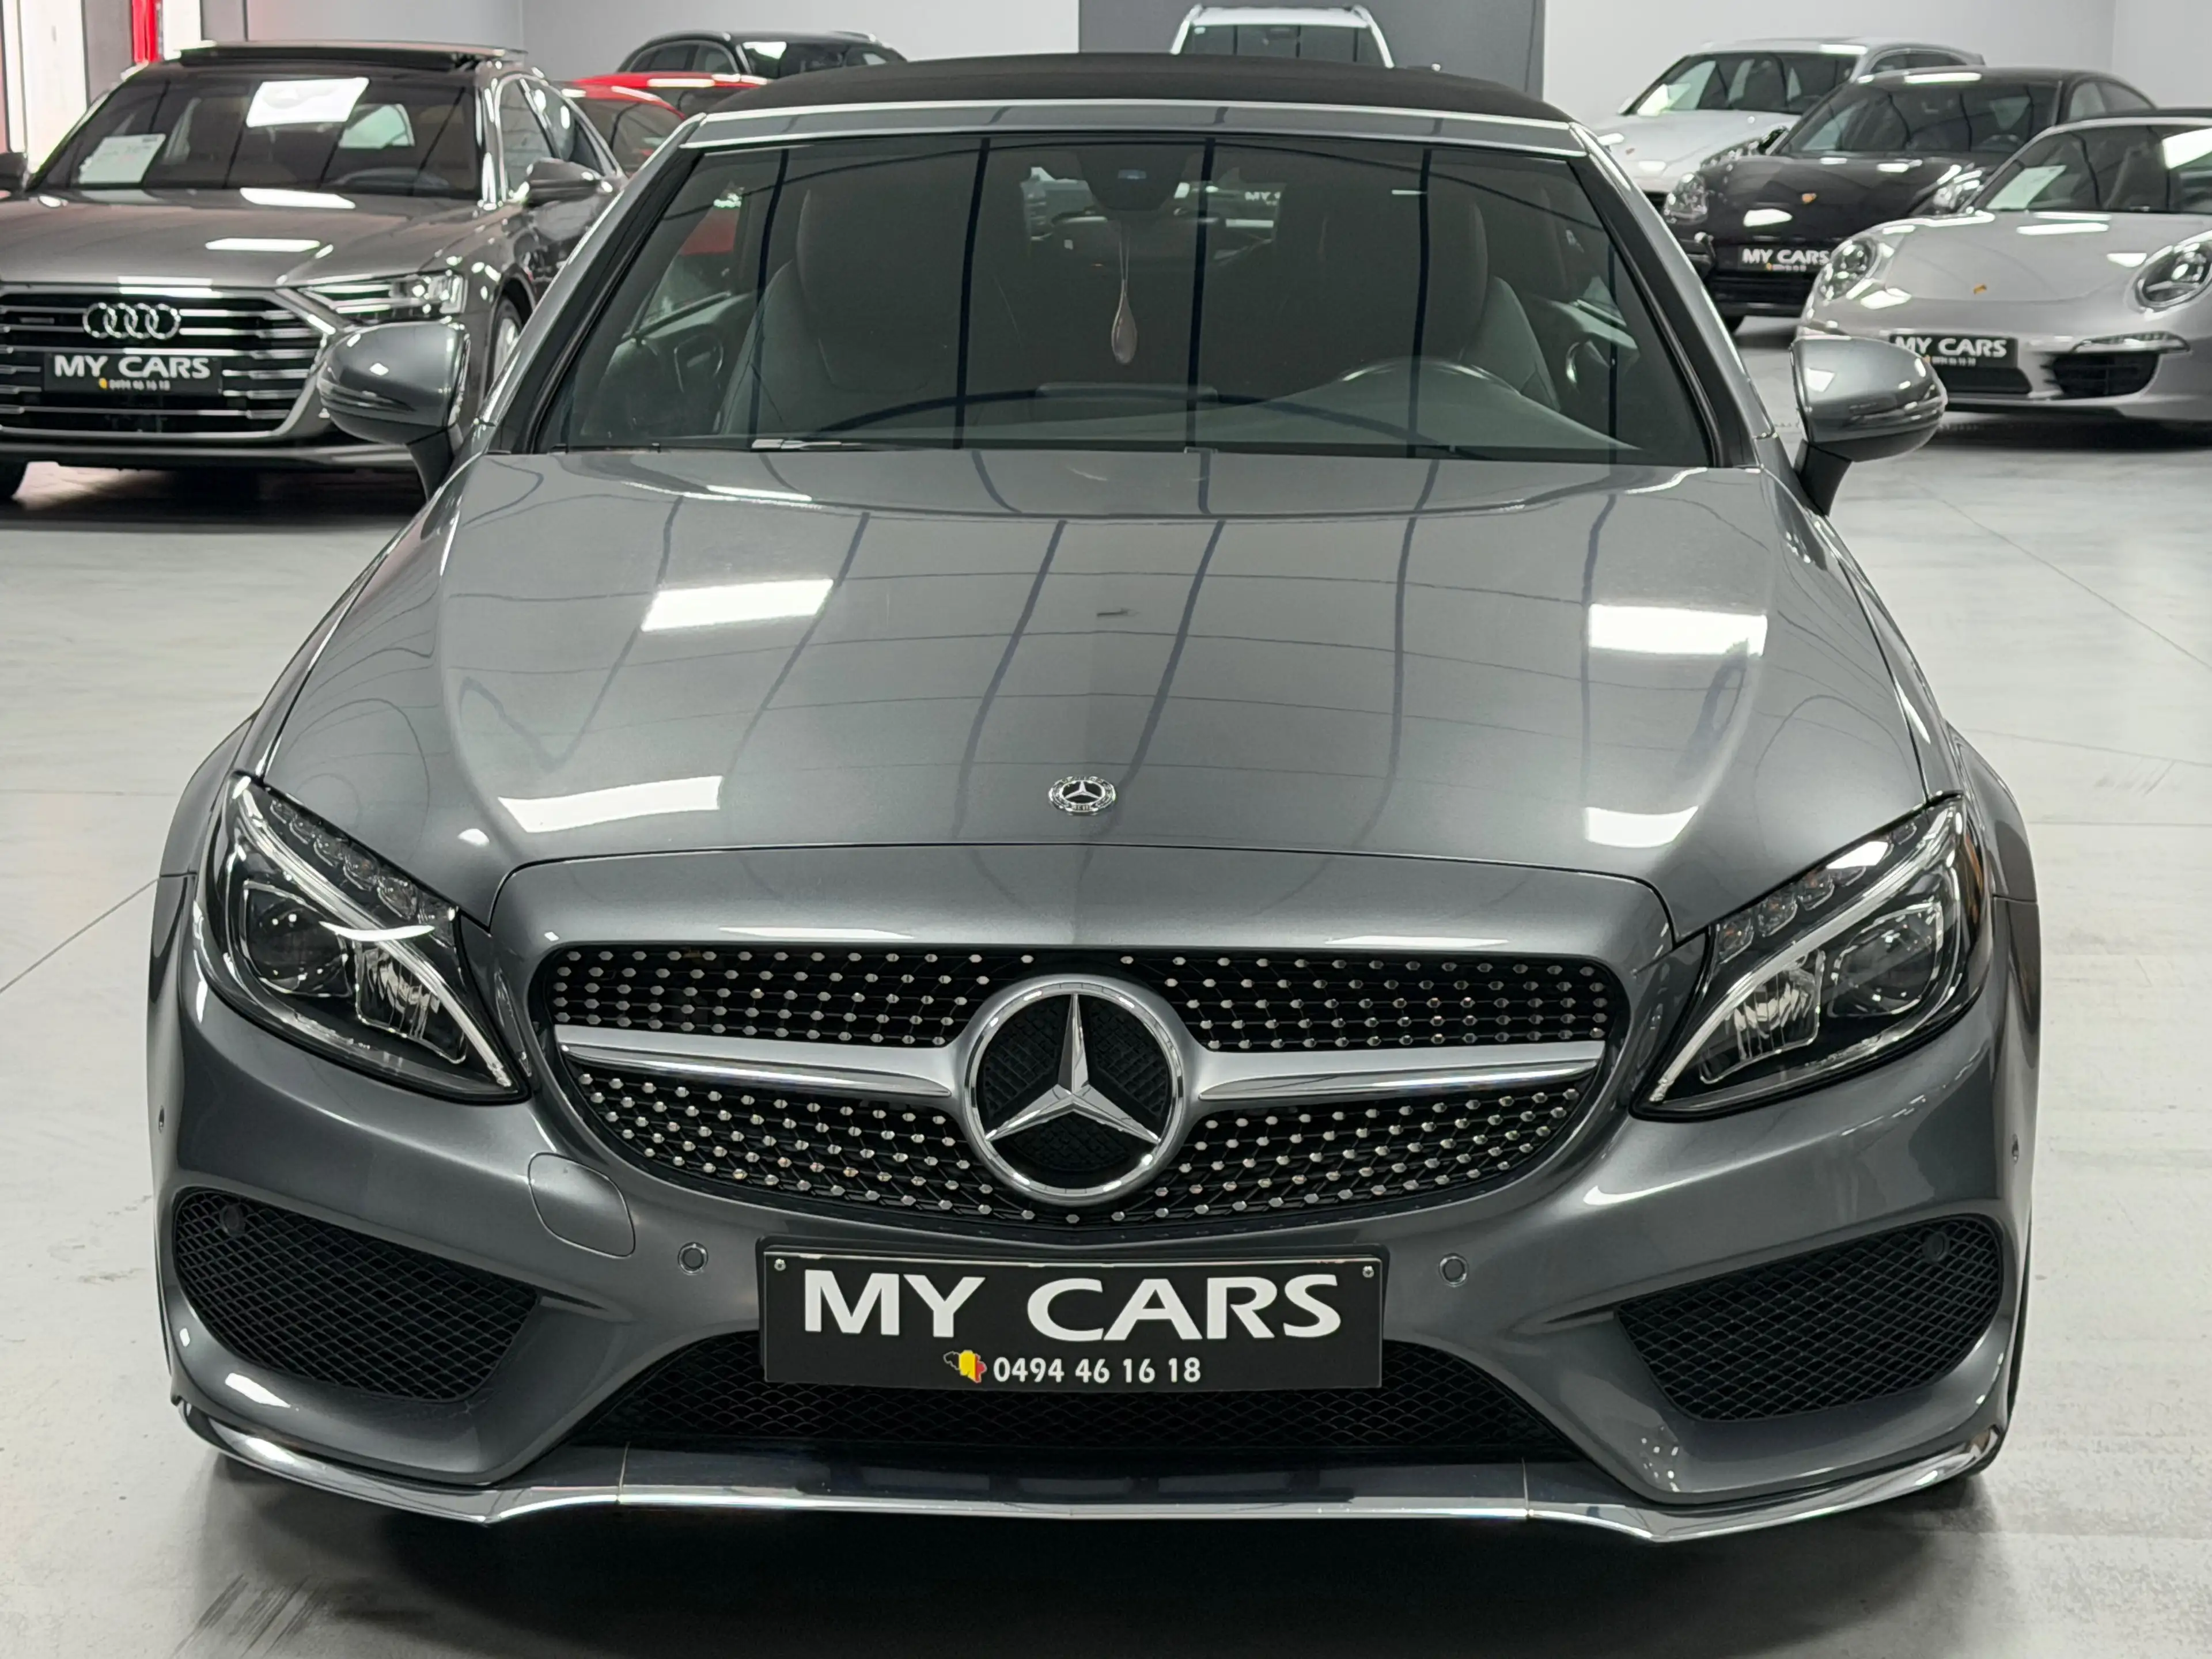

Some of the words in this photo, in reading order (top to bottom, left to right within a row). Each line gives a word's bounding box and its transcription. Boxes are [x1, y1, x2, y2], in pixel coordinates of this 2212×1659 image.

[1743, 248, 1773, 264] MY
[1777, 249, 1831, 265] CARS
[1895, 336, 1932, 354] MY
[1938, 338, 2007, 357] CARS
[54, 355, 108, 377] MY
[118, 357, 210, 378] CARS
[805, 1269, 986, 1338] MY
[1027, 1274, 1342, 1342] CARS
[993, 1357, 1065, 1382] 0494
[1075, 1358, 1109, 1383] 46
[1123, 1358, 1156, 1383] 16
[1168, 1357, 1201, 1382] 18
